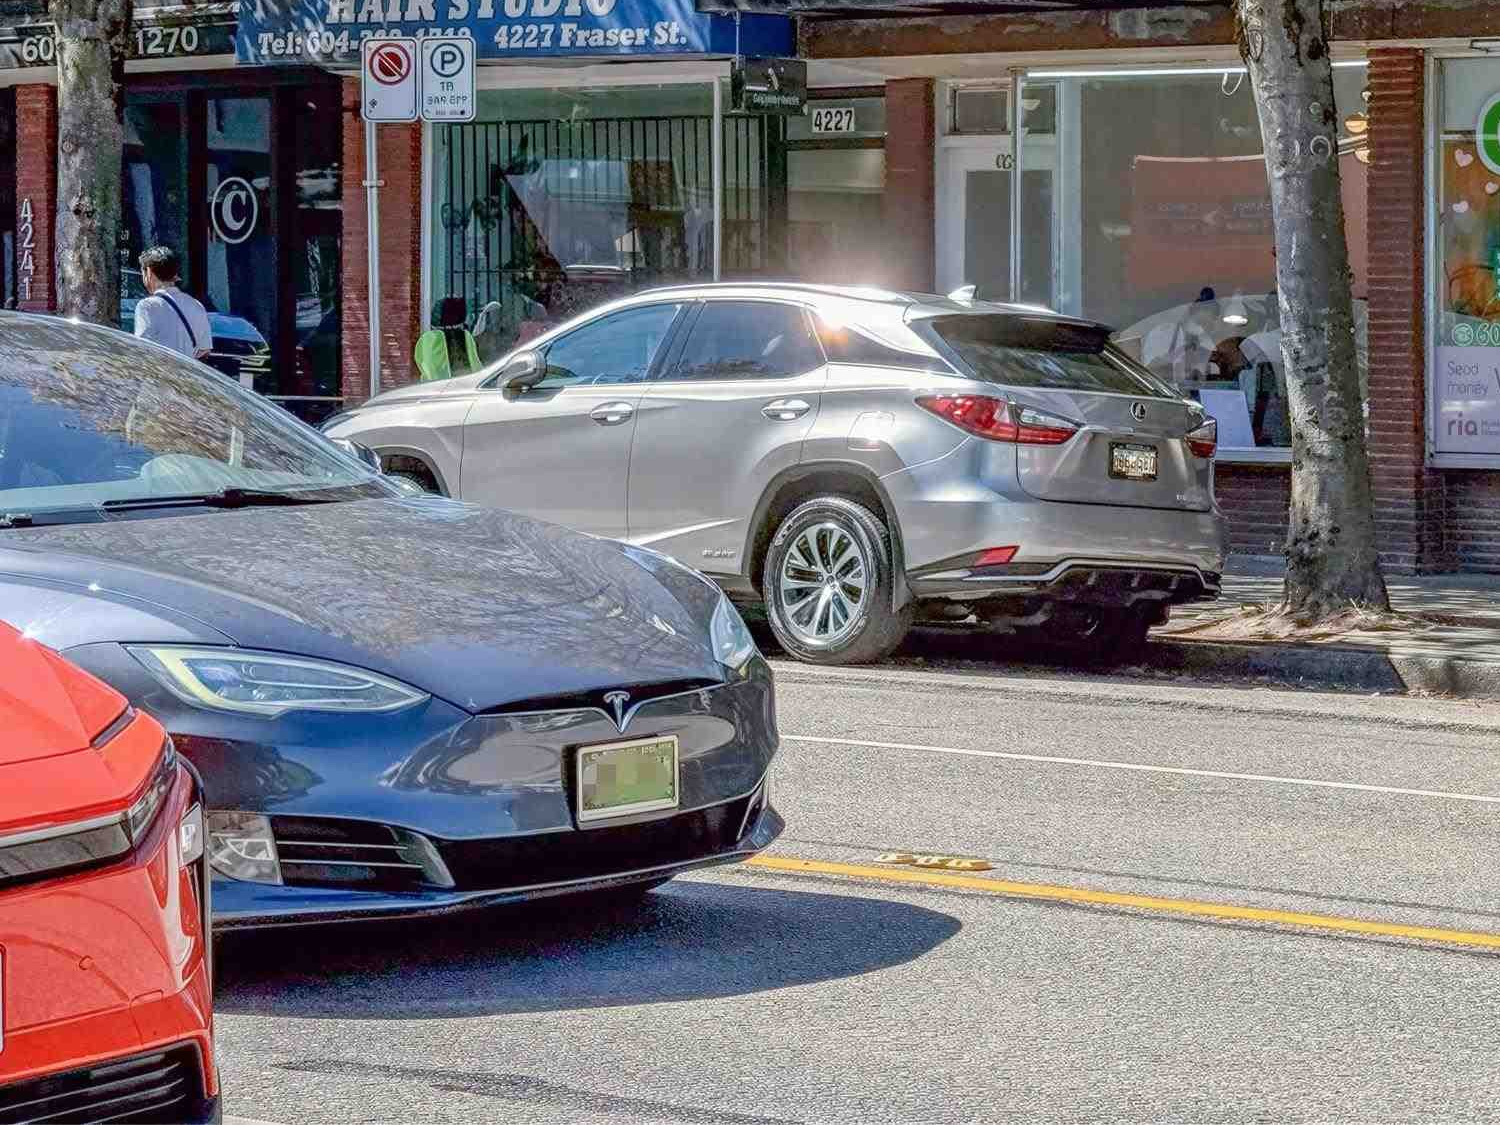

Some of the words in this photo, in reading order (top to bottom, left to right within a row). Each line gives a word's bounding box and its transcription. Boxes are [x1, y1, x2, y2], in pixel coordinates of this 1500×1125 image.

[135, 26, 198, 55] 1270
[494, 24, 554, 49] 4227
[559, 22, 650, 48] Fraser
[653, 20, 688, 46] St.
[440, 50, 457, 71] P
[813, 109, 854, 131] 4227
[1447, 412, 1479, 436] ria
